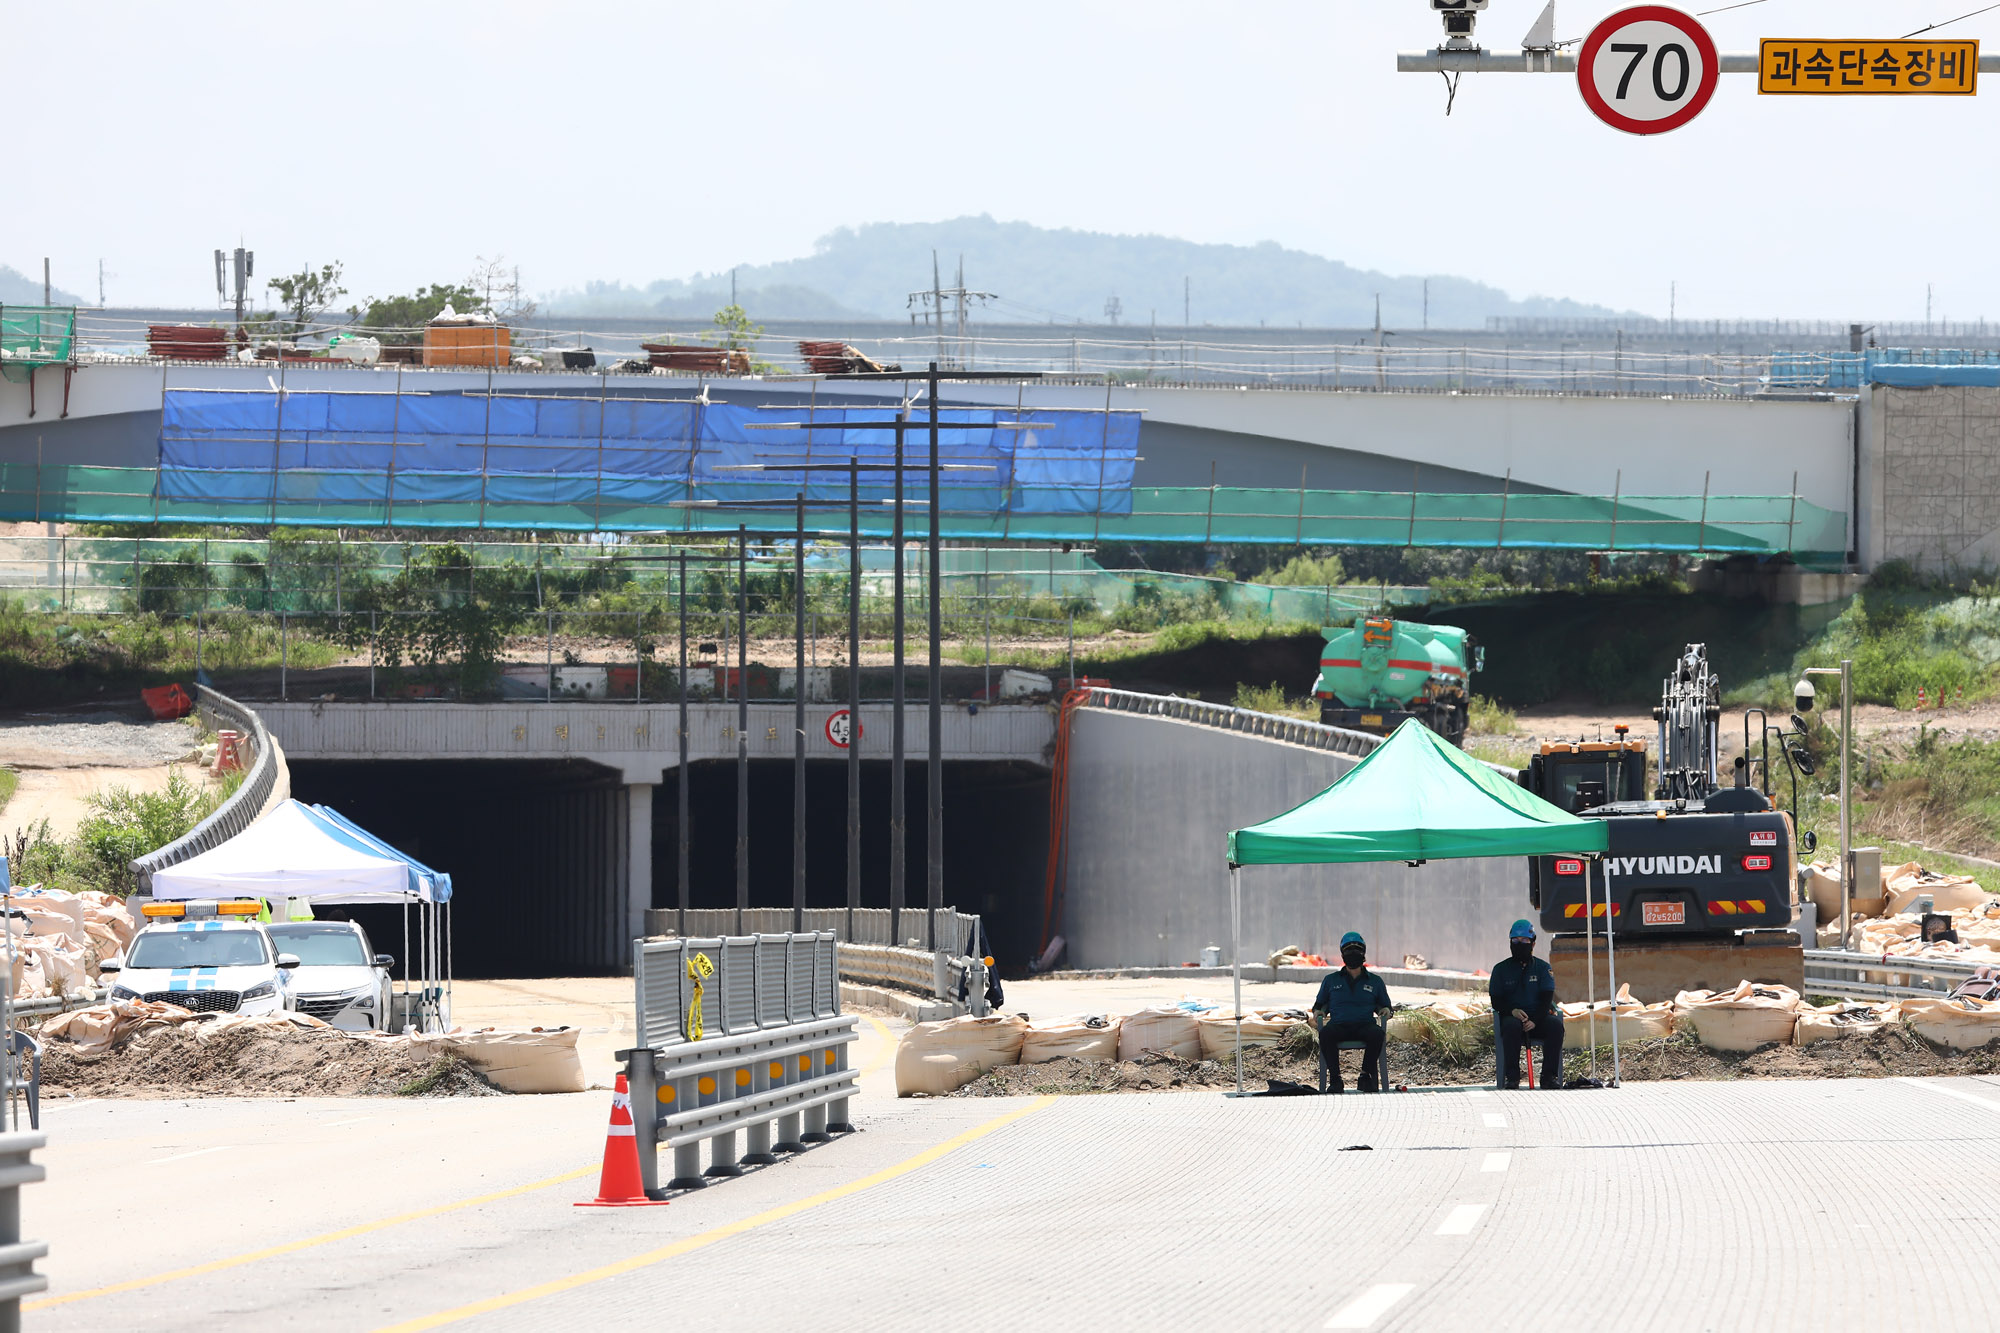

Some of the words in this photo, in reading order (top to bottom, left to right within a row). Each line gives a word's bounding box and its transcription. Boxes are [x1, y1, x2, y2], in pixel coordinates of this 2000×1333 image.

[1611, 43, 1690, 101] 70
[1770, 47, 1966, 87] 과속단속장비
[1603, 855, 1722, 876] HYUNDAI
